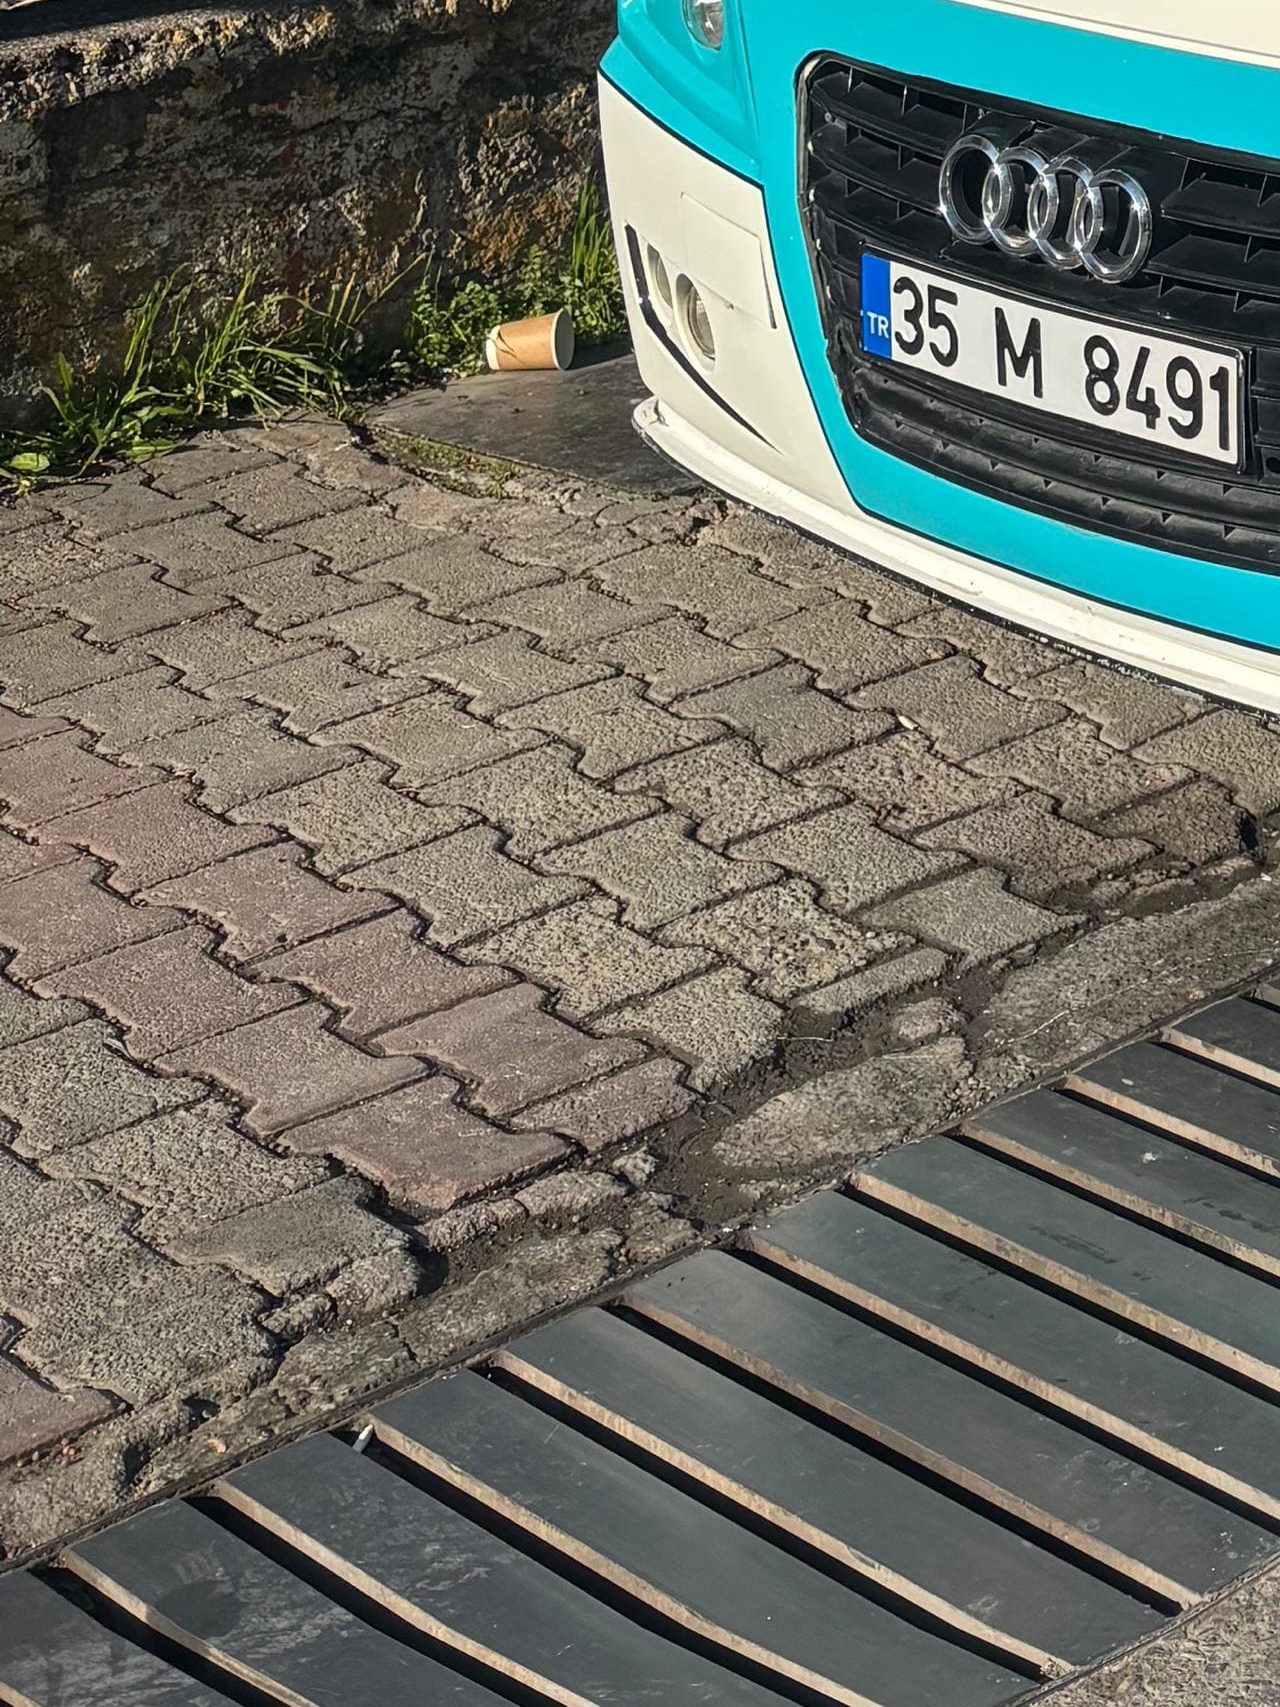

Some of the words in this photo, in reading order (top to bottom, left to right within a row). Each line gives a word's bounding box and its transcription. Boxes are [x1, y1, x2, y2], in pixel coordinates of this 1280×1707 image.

[867, 312, 889, 339] TR
[893, 276, 958, 368] 35
[994, 306, 1044, 399] M
[1083, 334, 1231, 451] 8491
